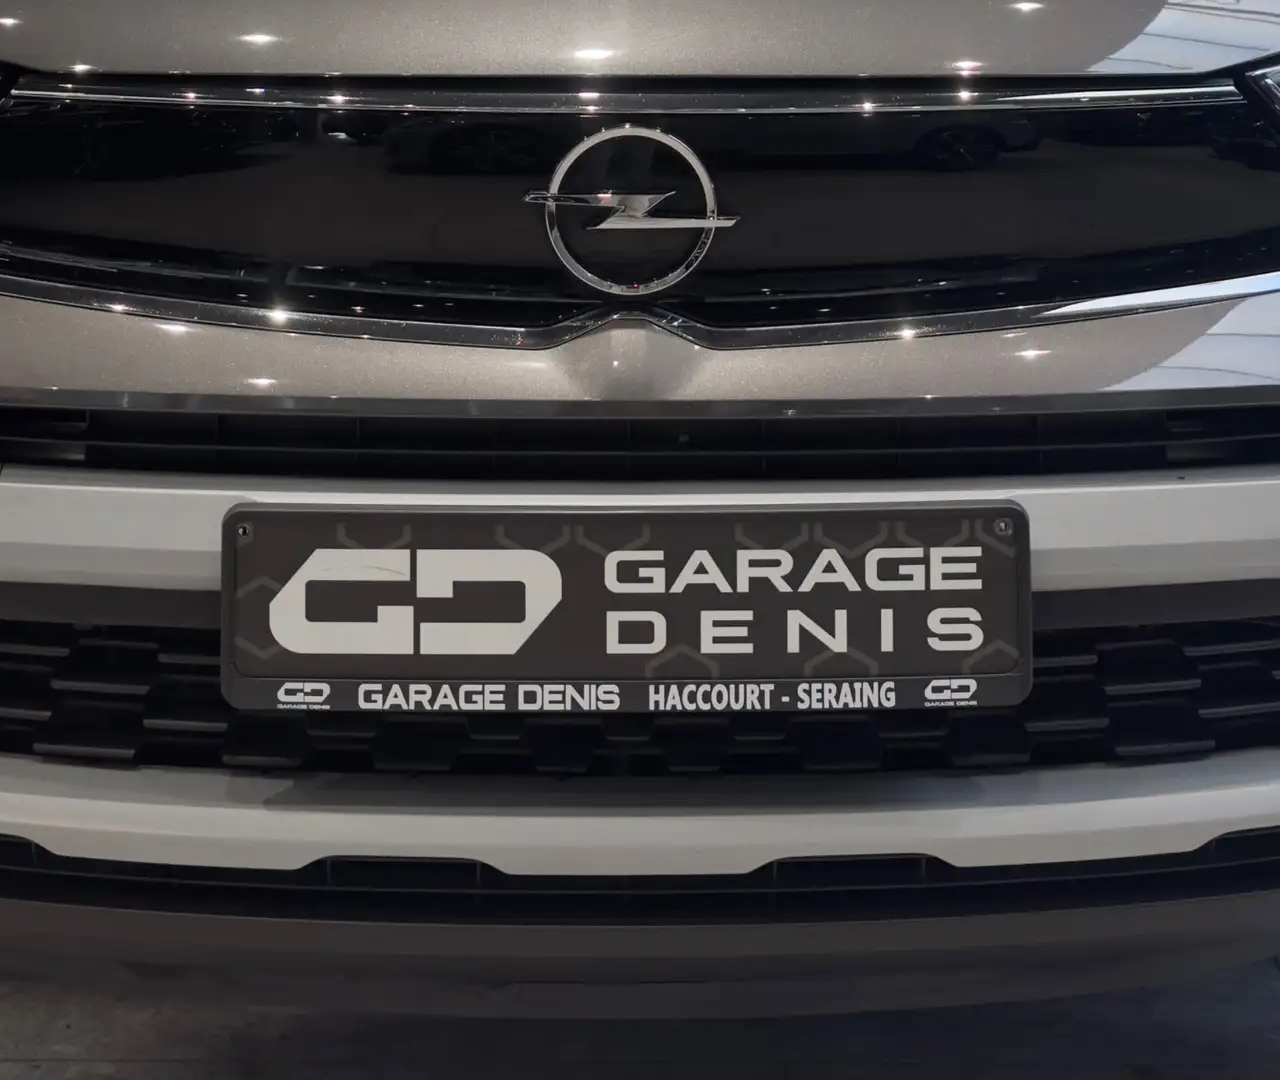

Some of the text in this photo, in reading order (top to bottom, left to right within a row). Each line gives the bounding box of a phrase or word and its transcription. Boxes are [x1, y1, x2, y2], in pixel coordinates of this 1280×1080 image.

[604, 547, 983, 594] GARAGE
[606, 608, 984, 655] DENIS
[357, 683, 621, 710] GARAGE DENIS
[648, 683, 775, 710] HACCOURT
[797, 681, 896, 710] SERAING
